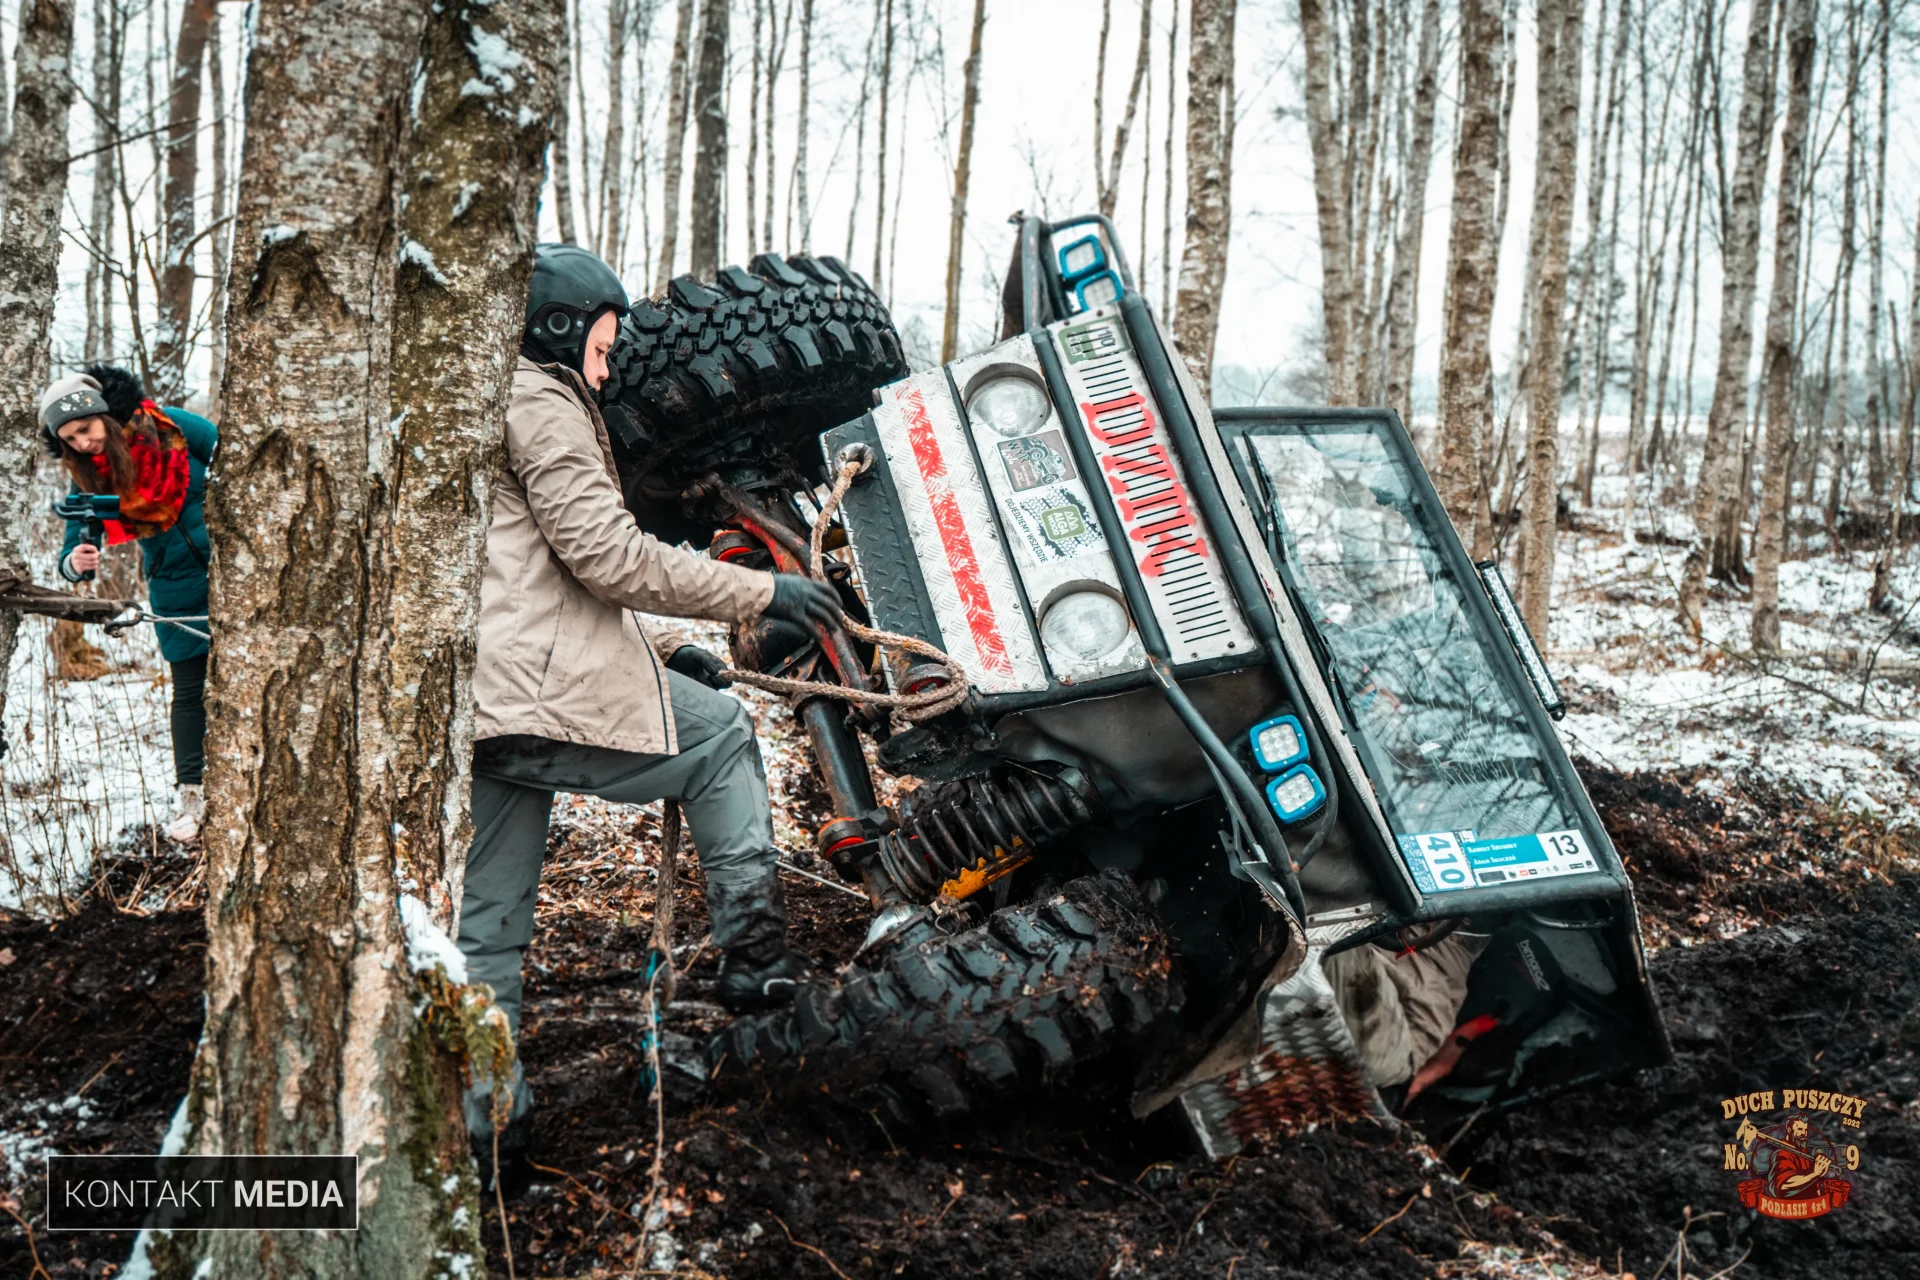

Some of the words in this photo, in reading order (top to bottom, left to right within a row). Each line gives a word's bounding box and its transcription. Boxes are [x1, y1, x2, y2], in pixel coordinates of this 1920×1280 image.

[1080, 391, 1209, 578] DZIK
[1005, 498, 1031, 534] DOJEDZIEMY
[1027, 533, 1048, 563] WSZĘDZIE
[1046, 514, 1060, 536] WOOD
[1053, 512, 1069, 536] ALGA
[1427, 836, 1466, 884] 410
[1548, 834, 1580, 856] 13
